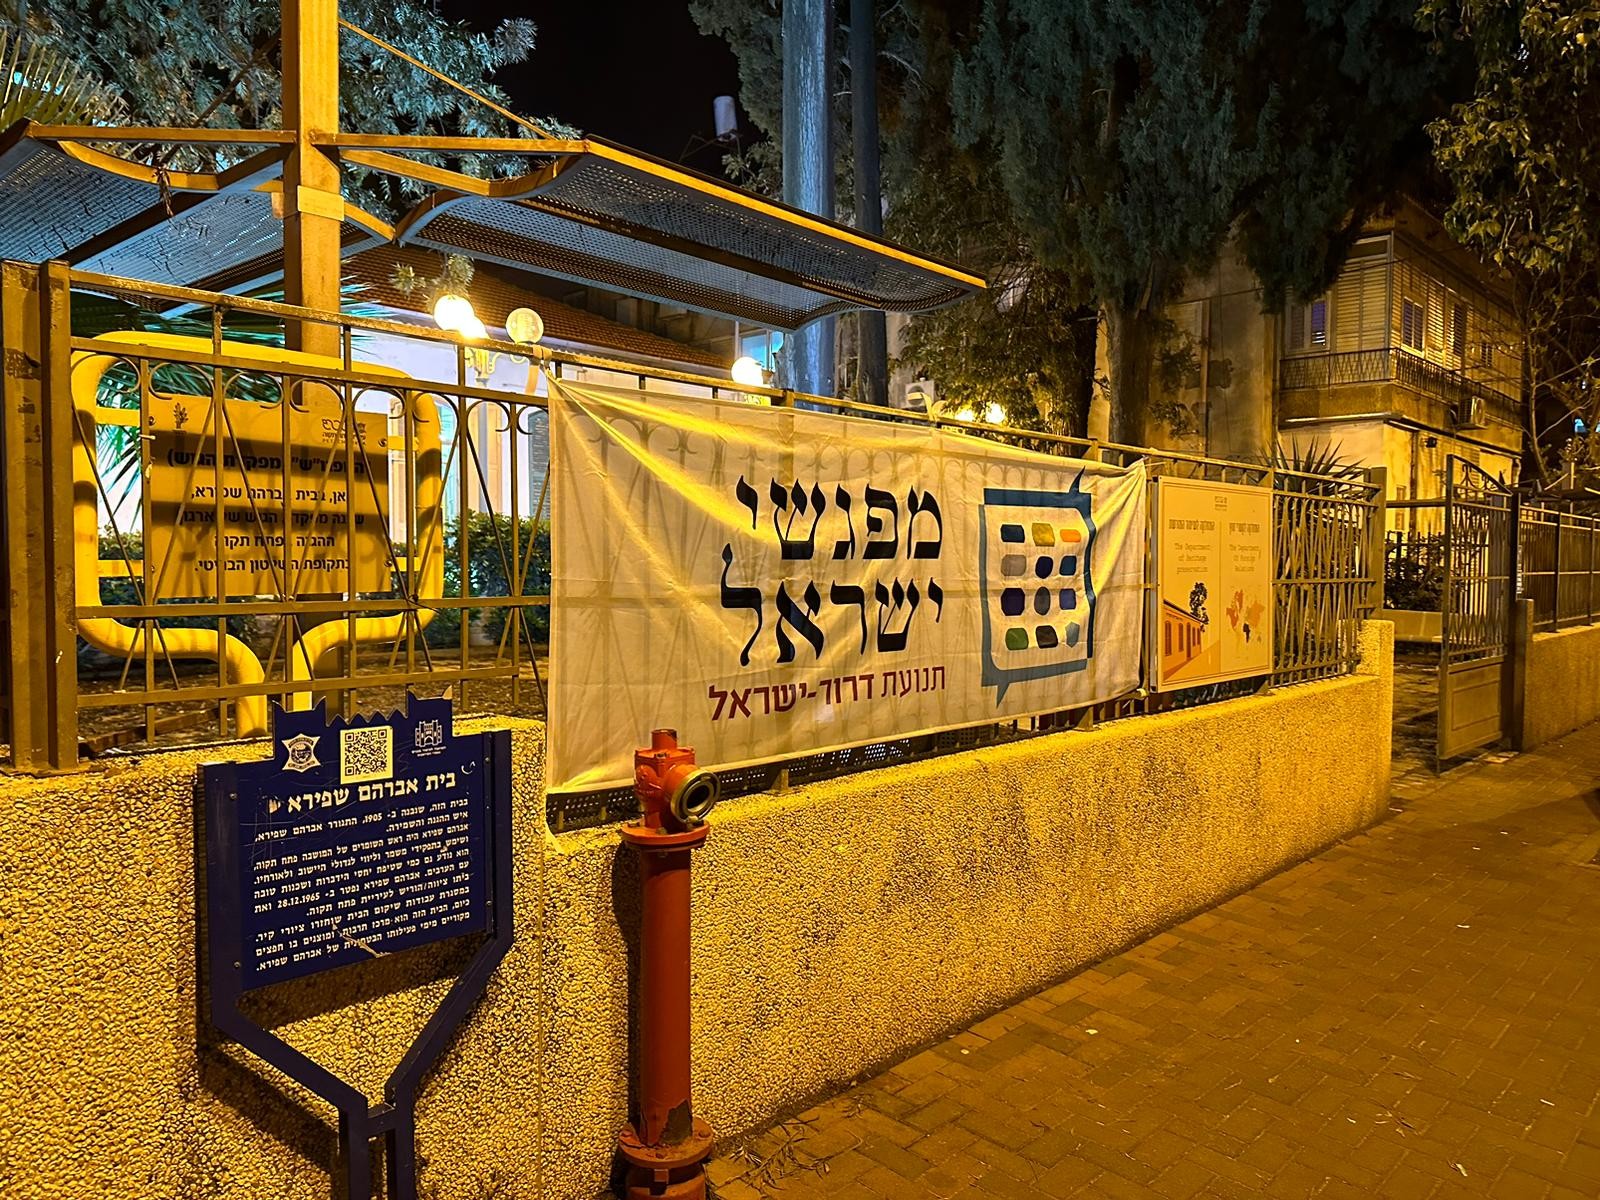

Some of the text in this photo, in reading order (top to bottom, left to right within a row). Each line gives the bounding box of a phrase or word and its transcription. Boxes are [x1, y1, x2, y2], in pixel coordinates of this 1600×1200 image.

[247, 486, 289, 500] ברהם
[735, 474, 943, 561] מפגשי
[296, 536, 335, 547] ההגה
[720, 543, 944, 667] ישראל
[708, 666, 946, 721] תנועת דרור-ישראל
[287, 772, 456, 814] בית אברהם שפירא
[450, 798, 469, 808] בבית
[401, 805, 425, 817] שנבנה
[327, 817, 358, 829] התגורר
[385, 810, 469, 833] איש ההגנה והשמירה.
[292, 823, 323, 835] אברהם
[254, 828, 288, 843] שפירא,
[253, 823, 469, 871] אברהם שפירא היה ראש השומרים של המושבה פתח תקוה,
[445, 835, 469, 849] ושימש
[360, 852, 381, 863] וליווי
[384, 847, 408, 859] משמר
[436, 851, 453, 862] נודע
[456, 848, 469, 857] הוא
[406, 858, 420, 867] כמי
[423, 855, 433, 864] גם
[458, 860, 470, 870] עם
[297, 863, 327, 876] היישוב
[353, 868, 372, 878] יחסי
[376, 861, 403, 874] שטיפח
[424, 863, 455, 877] הערבים.
[363, 877, 390, 890] שפירא
[394, 871, 421, 884] אברהם
[452, 872, 470, 883] ביתו
[254, 887, 277, 899] טובה
[281, 880, 312, 894] ושכנות
[339, 884, 360, 895] נפטר
[360, 888, 394, 904] לעיריית
[254, 902, 272, 914] ואת
[306, 903, 333, 916] תקוה.
[337, 898, 356, 909] פתח
[430, 904, 448, 915] הבית
[255, 886, 470, 942] במסגרת עבודות שיקום הבית שוחזרו ציורי קיר.
[394, 913, 409, 924] הוא
[412, 909, 427, 919] הזה
[441, 911, 470, 925] מקוריים
[371, 917, 391, 929] מרכז
[420, 919, 438, 930] מימי
[303, 929, 336, 946] ומוצגים
[386, 925, 416, 939] פעילותו
[255, 943, 284, 957] חפצים
[288, 939, 298, 949] בו
[326, 943, 340, 954] של
[293, 948, 322, 962] אברהם
[256, 956, 288, 971] שפירא.
